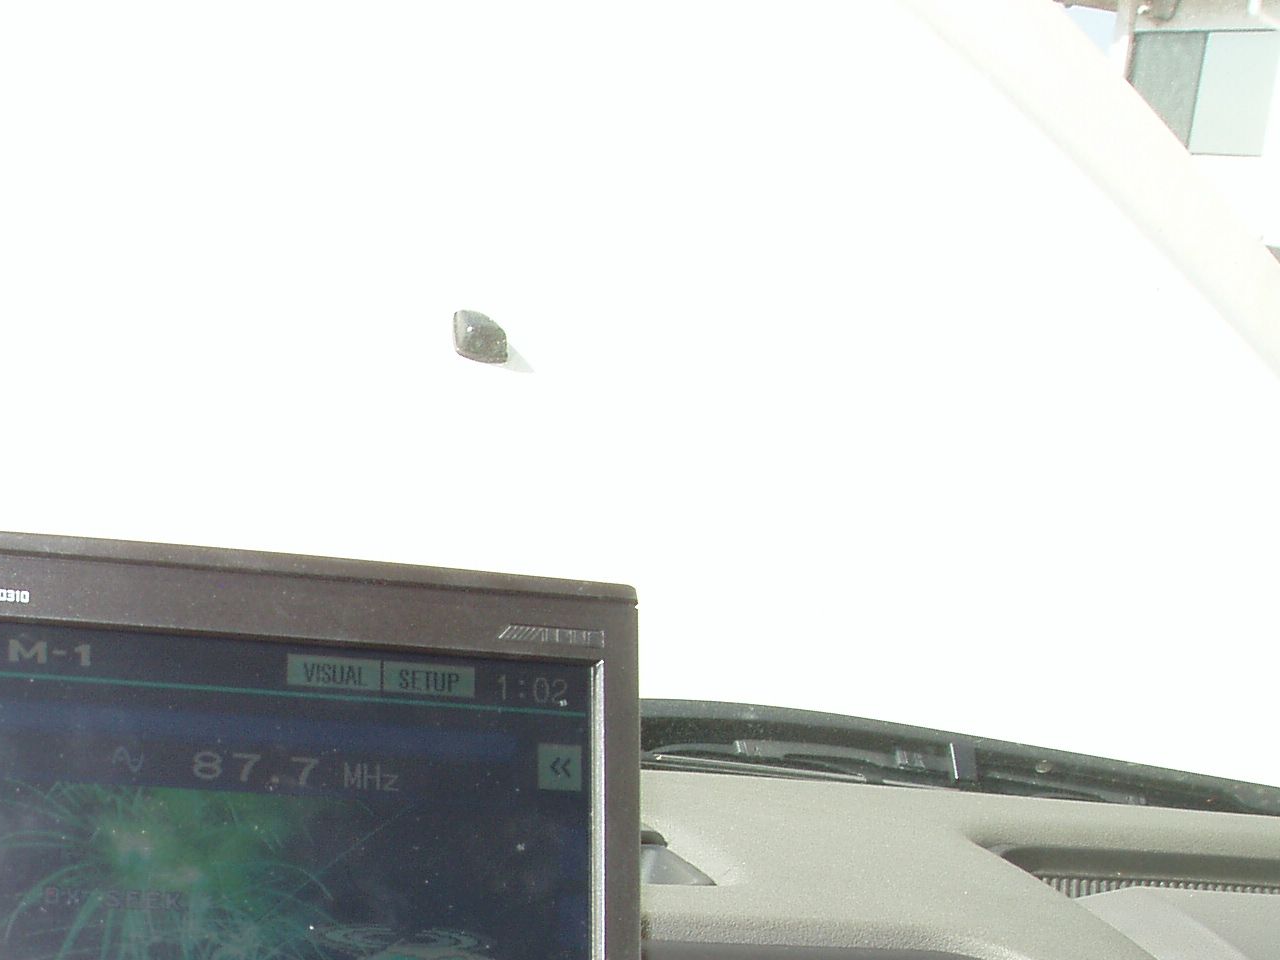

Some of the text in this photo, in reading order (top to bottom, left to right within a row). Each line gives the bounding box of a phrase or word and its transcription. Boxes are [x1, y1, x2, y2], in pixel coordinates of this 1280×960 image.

[303, 662, 368, 686] VISUAL
[398, 669, 460, 693] SETUP
[496, 674, 568, 704] 1:02
[193, 751, 400, 792] 87.7 MHz
